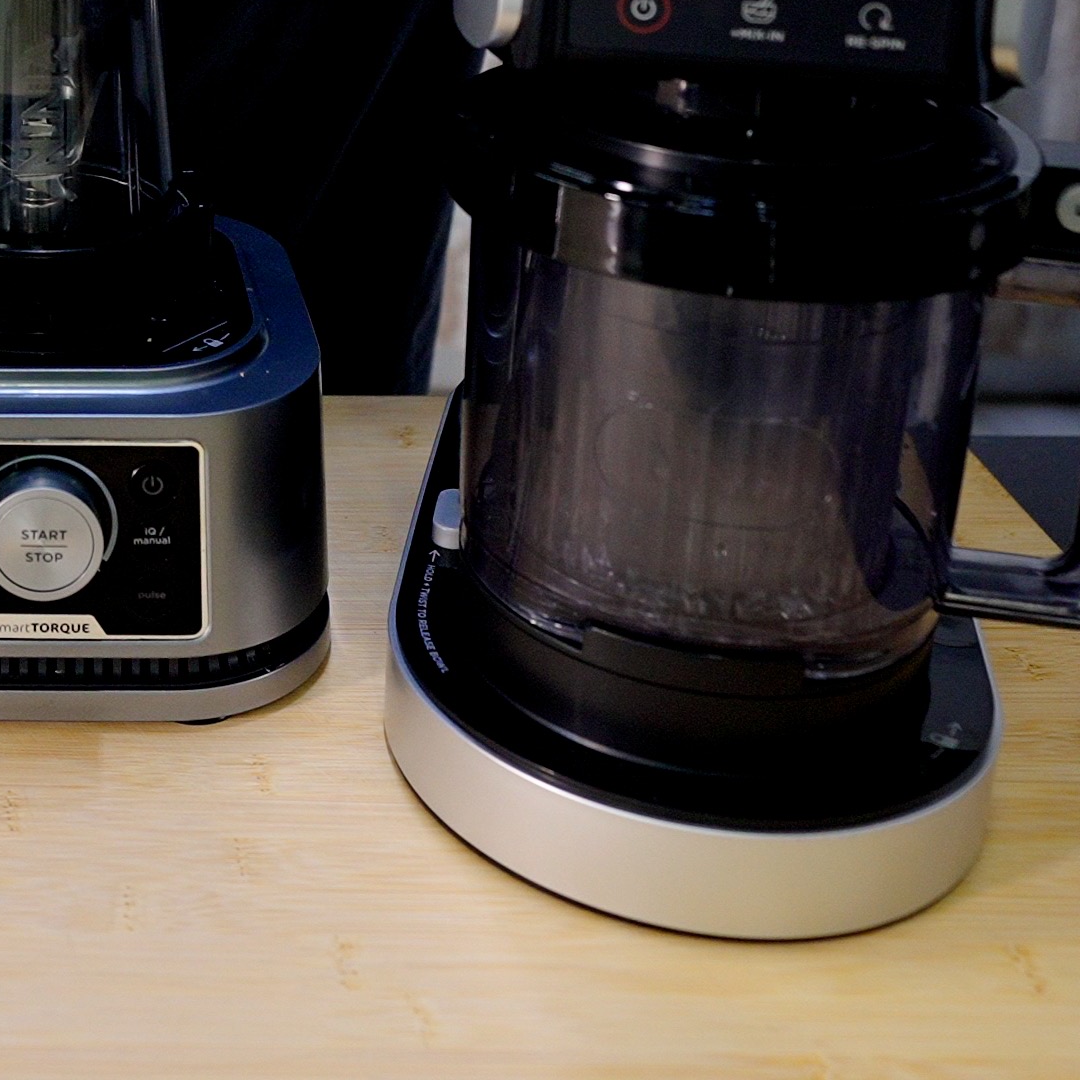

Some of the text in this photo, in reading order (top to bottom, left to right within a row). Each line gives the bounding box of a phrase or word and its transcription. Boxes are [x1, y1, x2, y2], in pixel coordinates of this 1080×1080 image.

[21, 529, 67, 541] START
[133, 536, 172, 545] manual
[25, 552, 64, 564] STOP
[424, 564, 436, 582] HOLD
[137, 591, 167, 601] pulse
[418, 588, 431, 608] TWIST
[417, 609, 427, 618] TO
[418, 619, 436, 651] RELEASE
